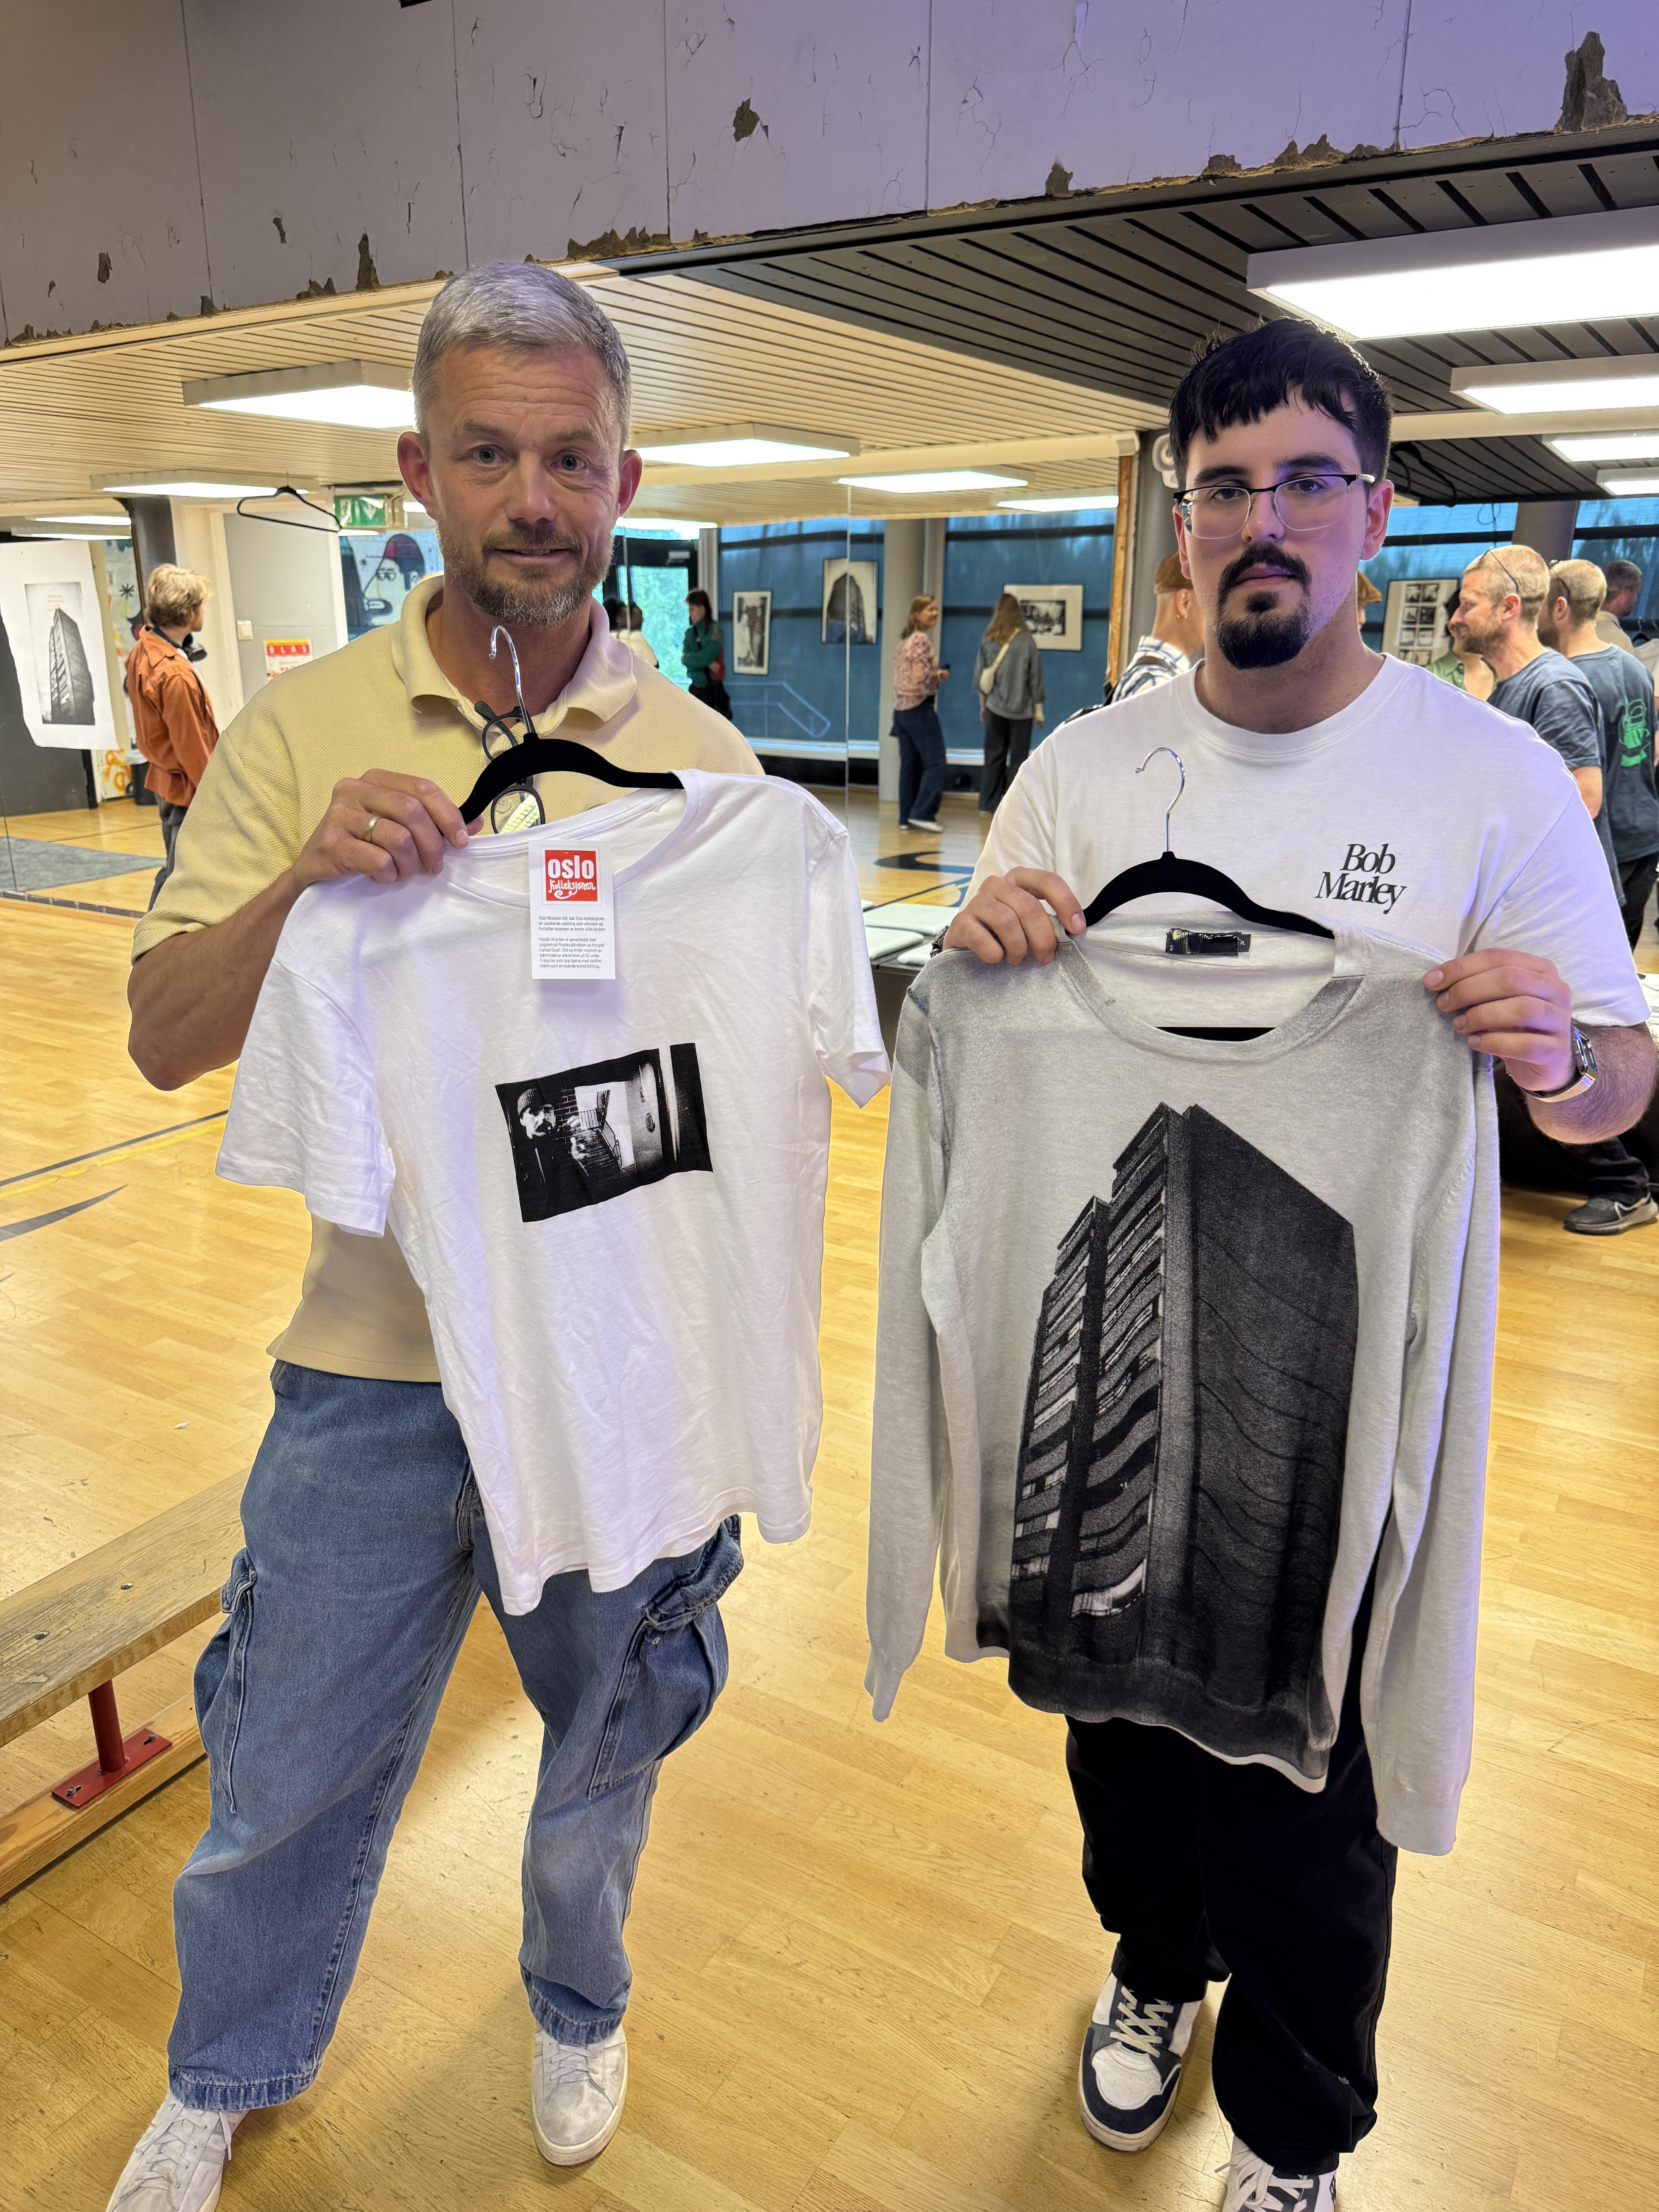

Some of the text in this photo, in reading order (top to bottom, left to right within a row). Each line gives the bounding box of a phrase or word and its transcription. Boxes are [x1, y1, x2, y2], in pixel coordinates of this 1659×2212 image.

[548, 855, 594, 879] oslo
[1339, 843, 1396, 874] Bob
[1314, 871, 1407, 914] Marley
